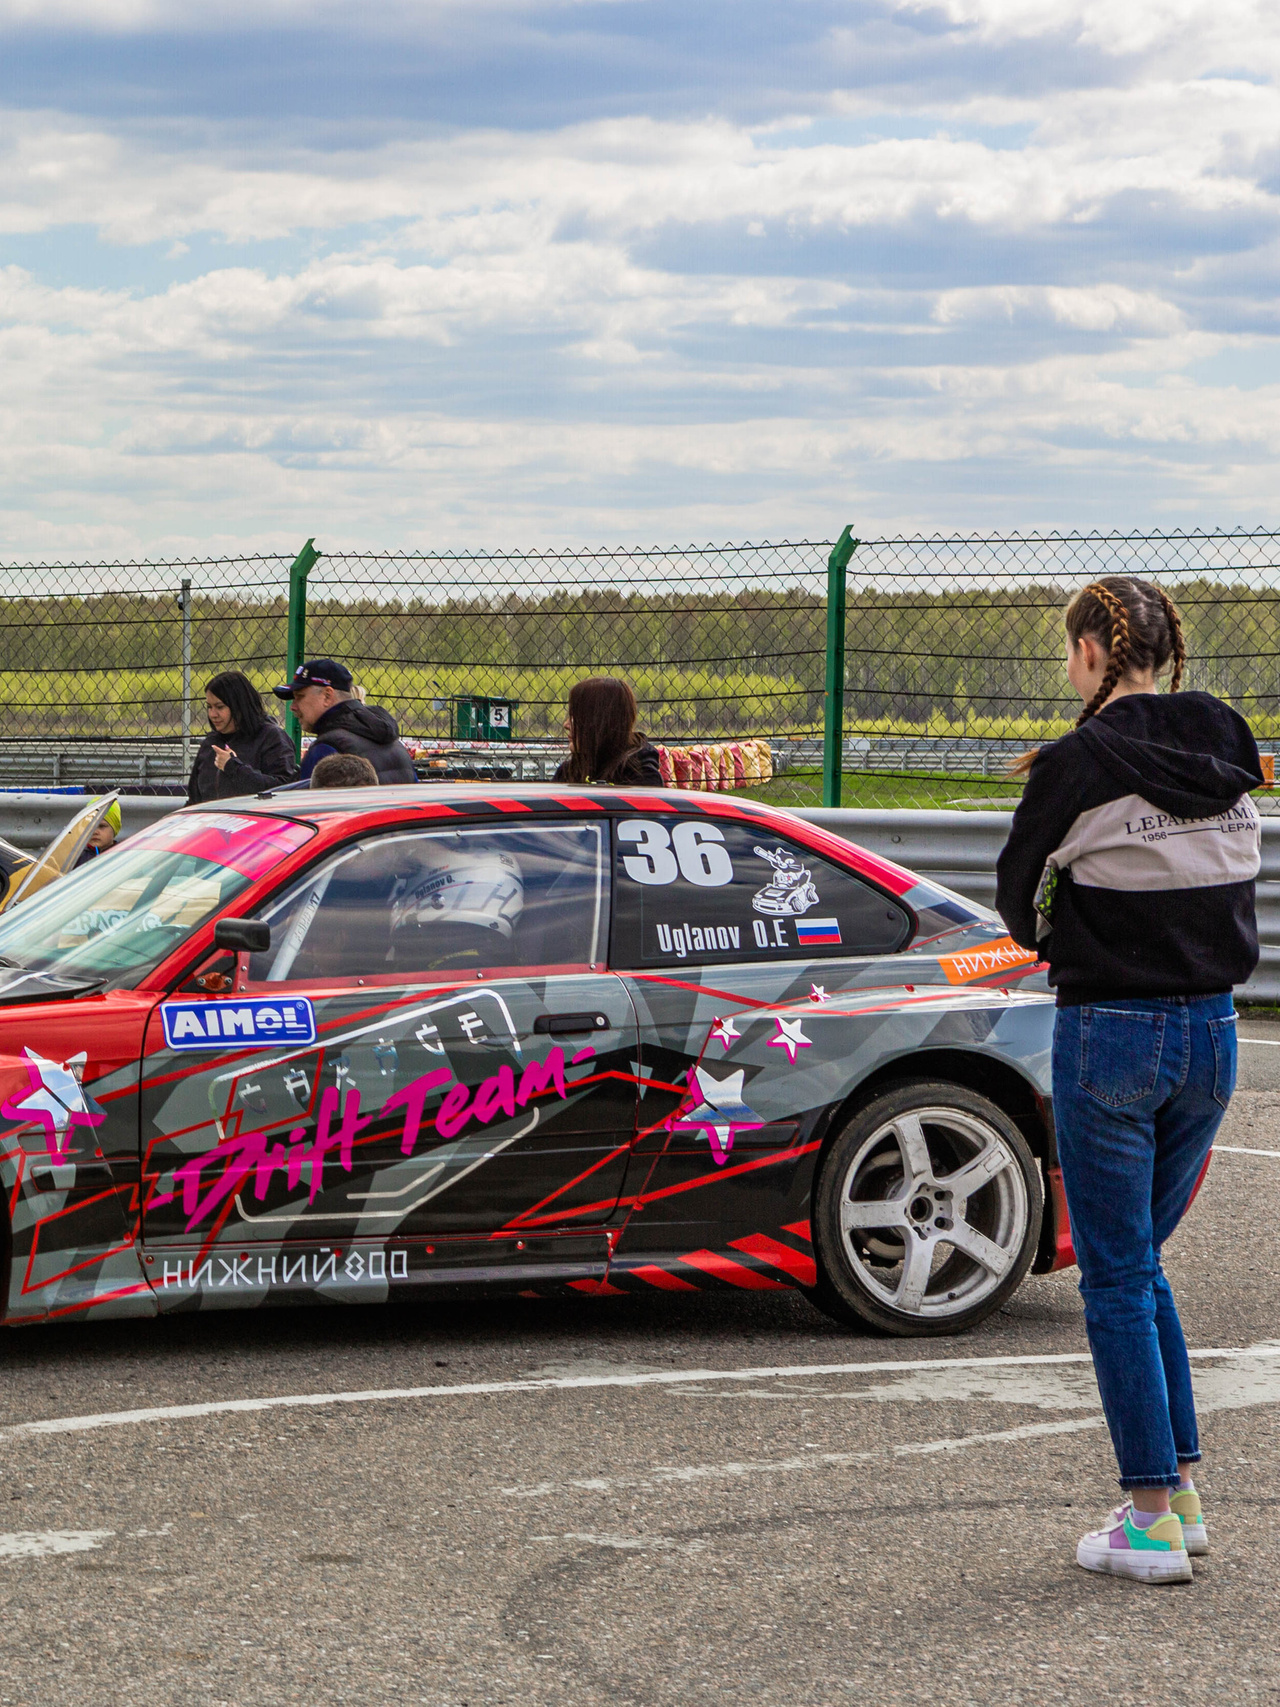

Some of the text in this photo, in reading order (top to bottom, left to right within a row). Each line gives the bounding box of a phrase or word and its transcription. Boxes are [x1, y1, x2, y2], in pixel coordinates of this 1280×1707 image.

[494, 708, 503, 721] 5
[616, 819, 734, 887] 36
[1141, 831, 1168, 843] 1956
[655, 921, 741, 958] Uglanov
[172, 1004, 309, 1039] AIMOL
